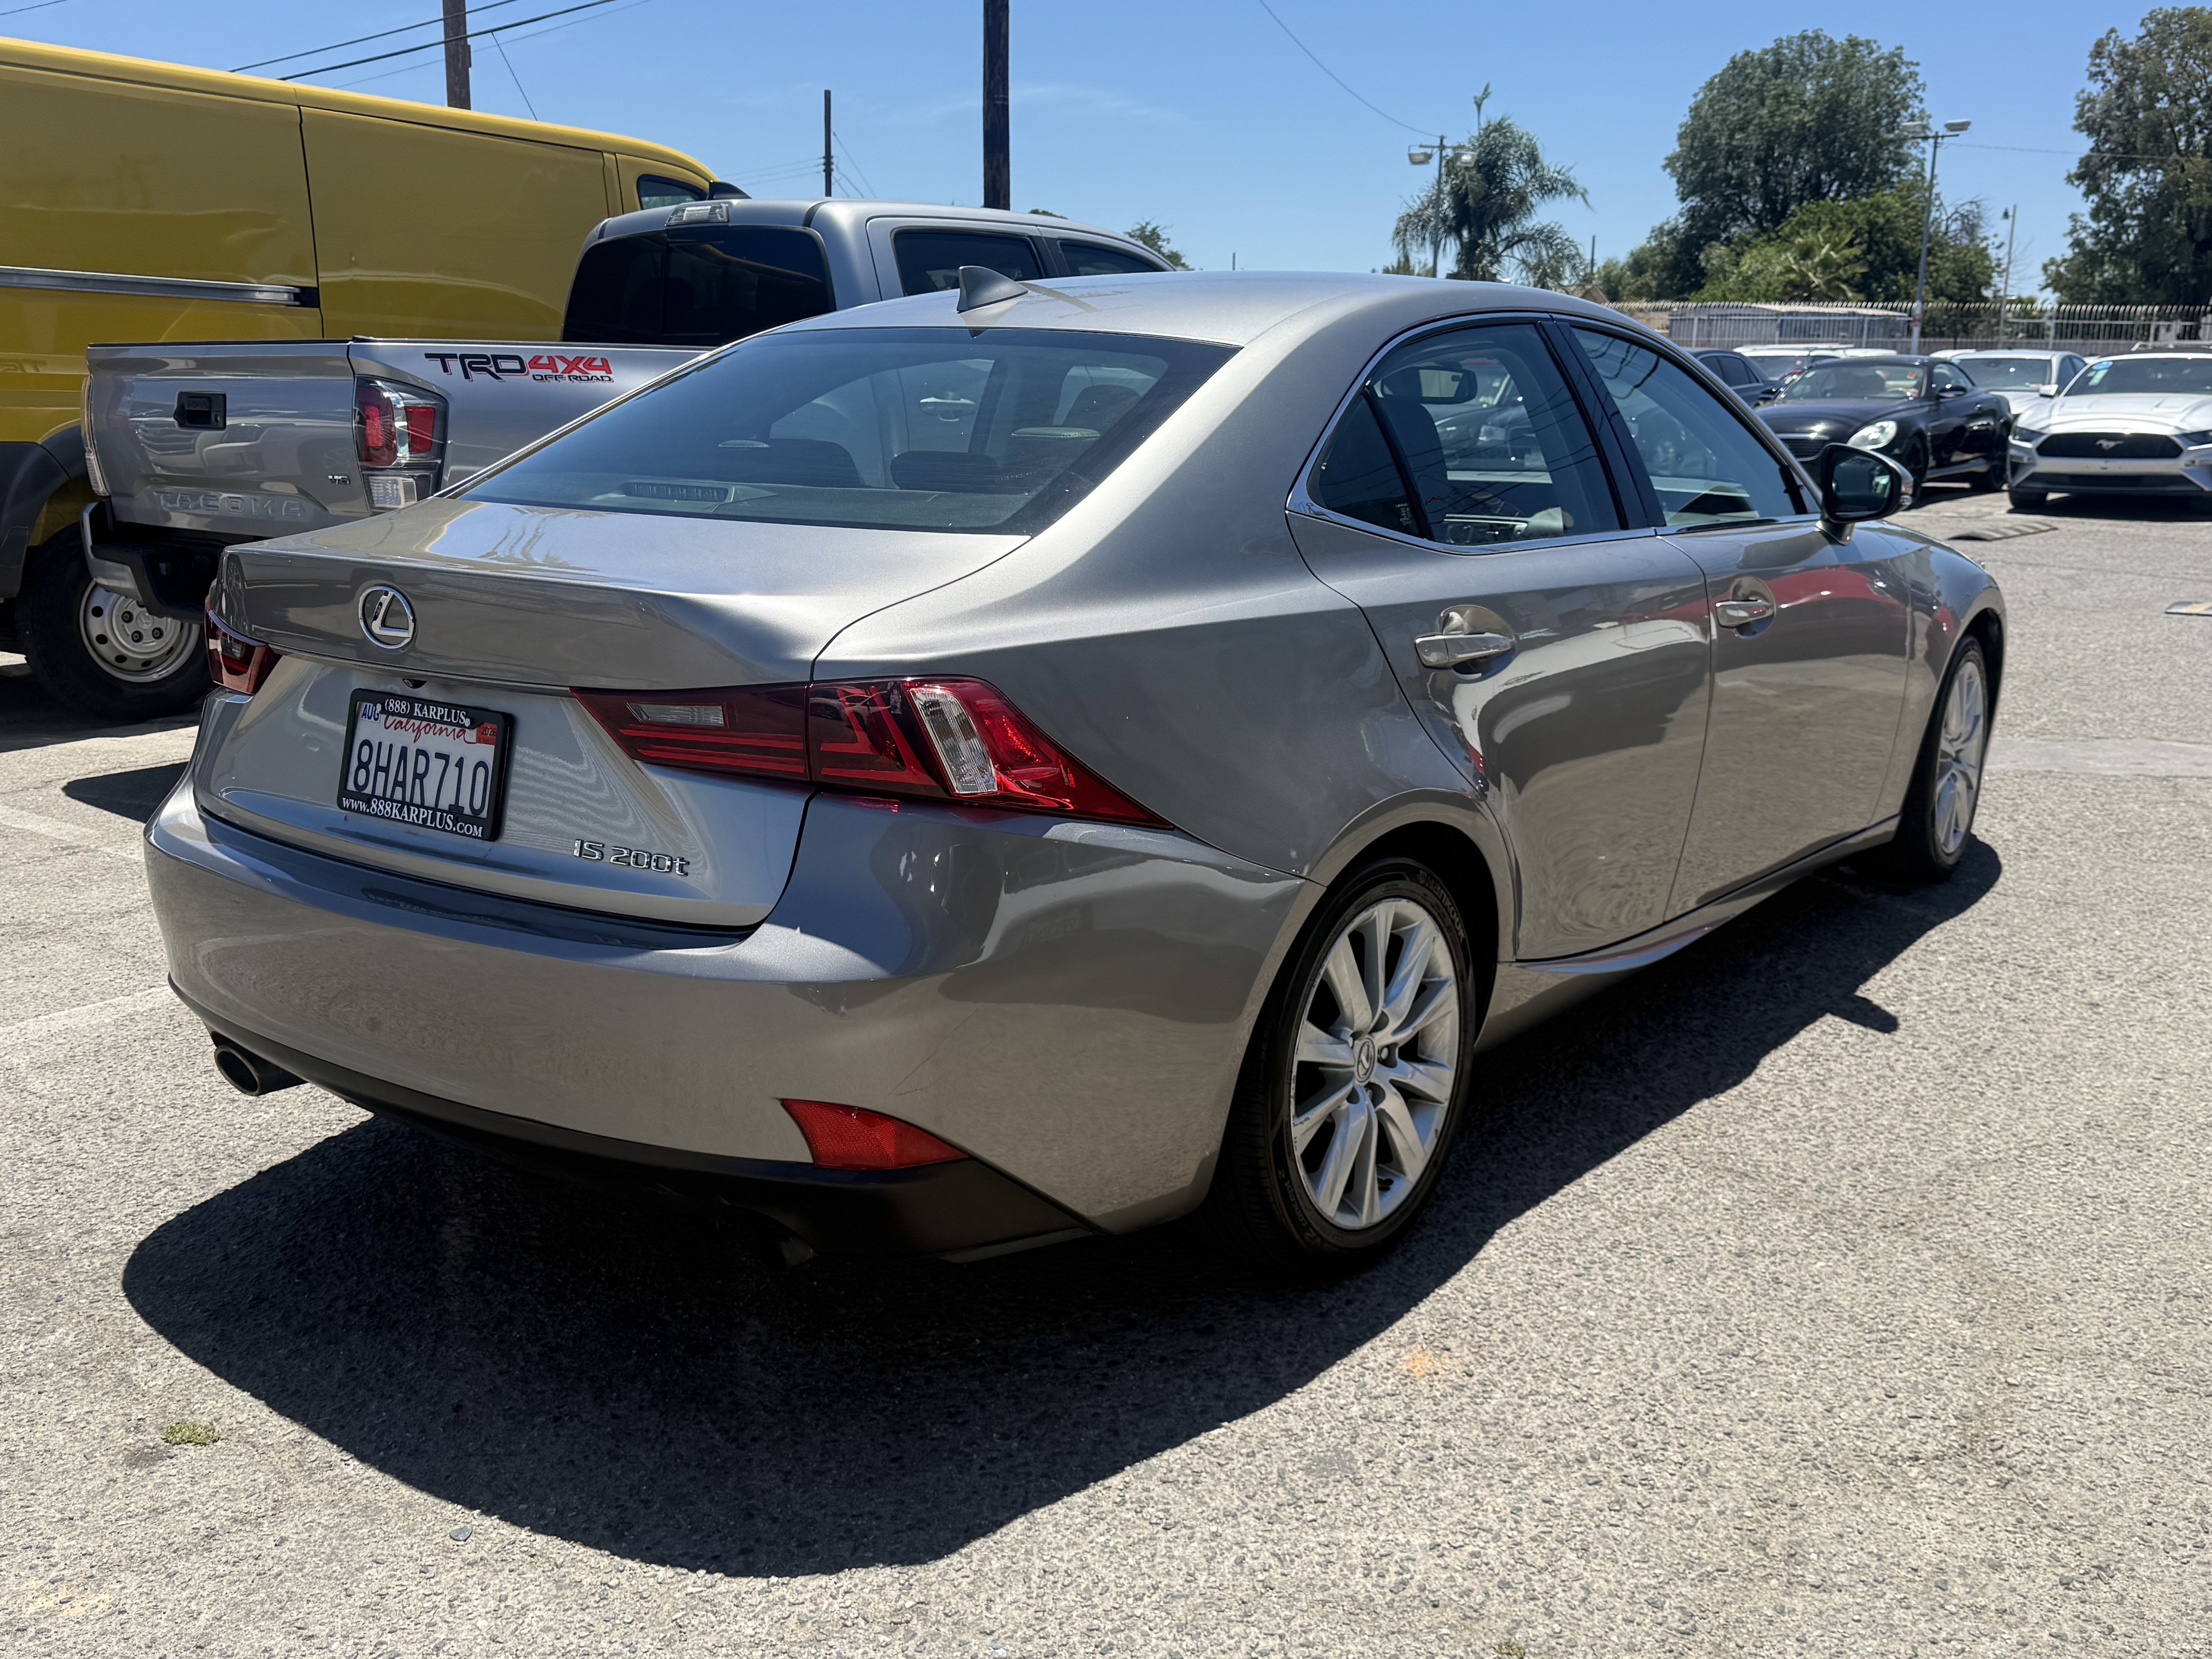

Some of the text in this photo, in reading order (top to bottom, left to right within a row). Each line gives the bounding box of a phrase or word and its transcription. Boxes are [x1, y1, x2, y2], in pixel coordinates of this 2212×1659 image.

[532, 374, 614, 383] OFF ROAD
[153, 489, 306, 518] TACOMA
[361, 704, 380, 721] AUG
[385, 698, 466, 724] (888) KARPLUS
[384, 714, 477, 744] California
[353, 739, 489, 816] 8HAR710
[574, 838, 690, 876] IS 200t
